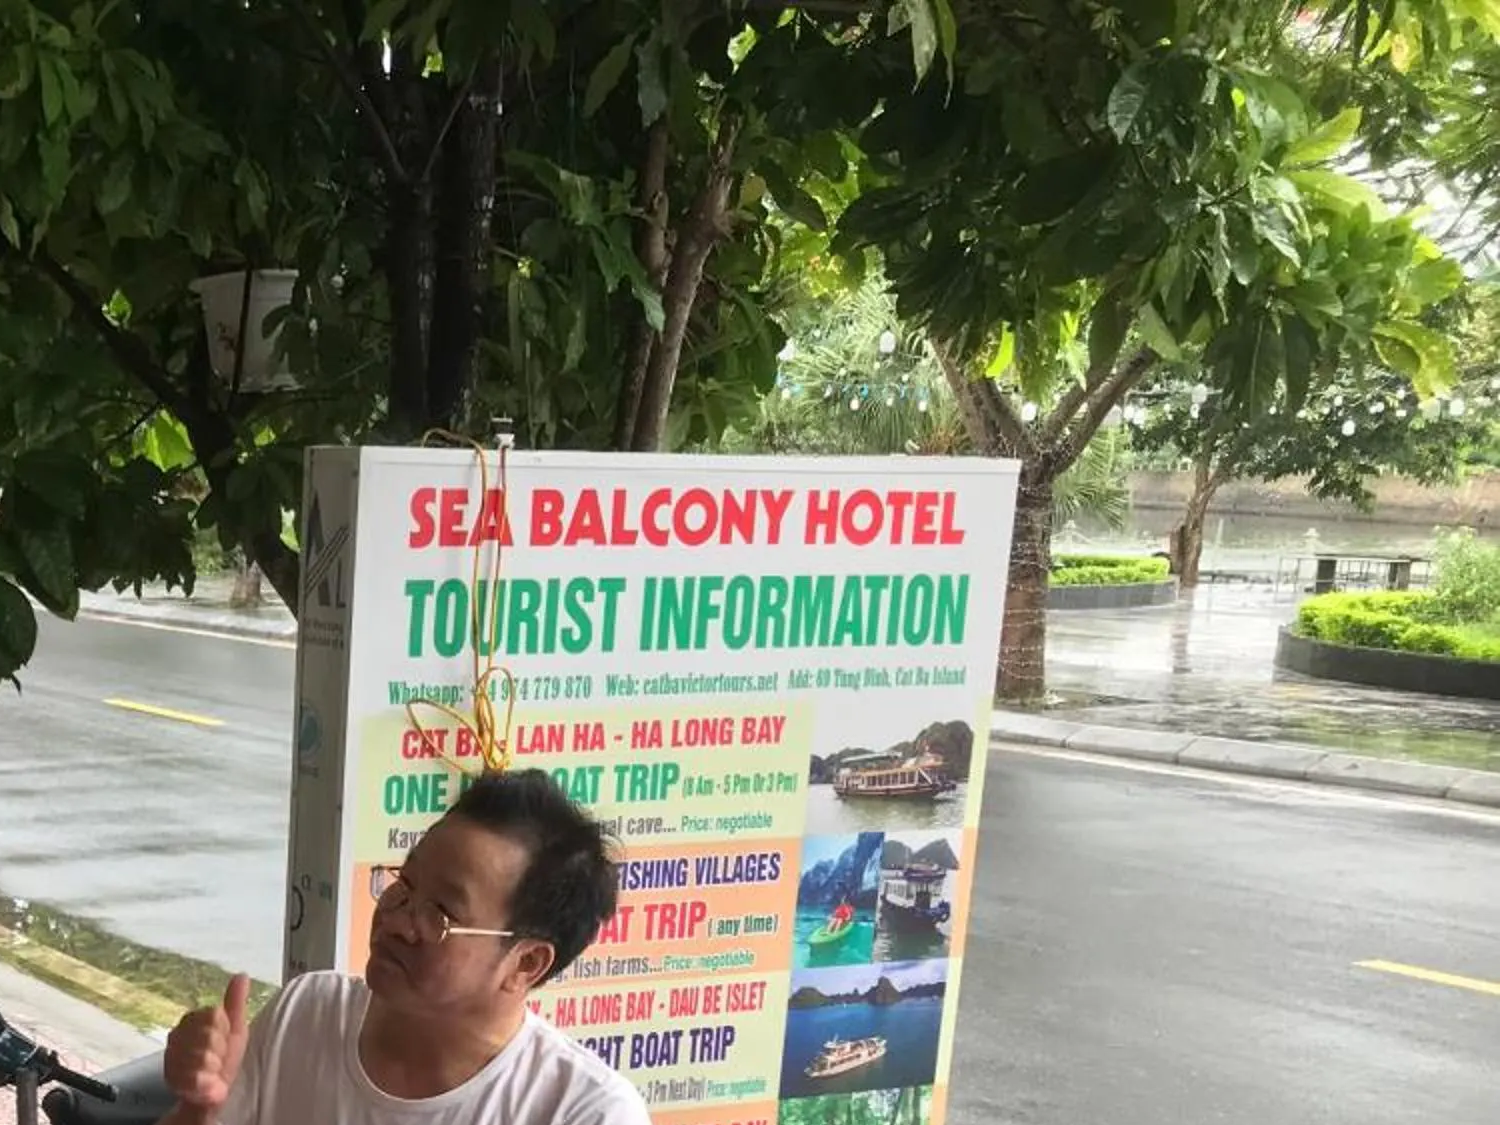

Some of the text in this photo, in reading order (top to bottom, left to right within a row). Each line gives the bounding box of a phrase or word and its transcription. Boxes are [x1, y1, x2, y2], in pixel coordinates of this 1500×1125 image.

[408, 487, 965, 549] SEA BALCONY HOTEL
[404, 576, 627, 658] TOURIST
[639, 573, 970, 652] INFORMATION
[388, 681, 465, 706] Whatsapp:
[606, 673, 640, 697] Web:
[401, 728, 449, 760] CAT
[516, 724, 565, 755] LAN
[573, 722, 606, 753] HA
[631, 719, 662, 750] HA
[671, 716, 735, 748] LONG
[740, 715, 786, 745] BAY
[383, 773, 449, 815] ONE
[614, 762, 680, 803] TRIP
[695, 851, 781, 886] VILLAGES
[643, 901, 707, 942] TRIP
[555, 997, 577, 1028] HA
[582, 993, 621, 1025] LONG
[626, 989, 655, 1021] BAY
[669, 987, 700, 1018] DAU
[702, 984, 724, 1015] BE
[726, 980, 767, 1013] ISLET
[629, 1029, 683, 1070] BOAT
[689, 1025, 735, 1064] TRIP
